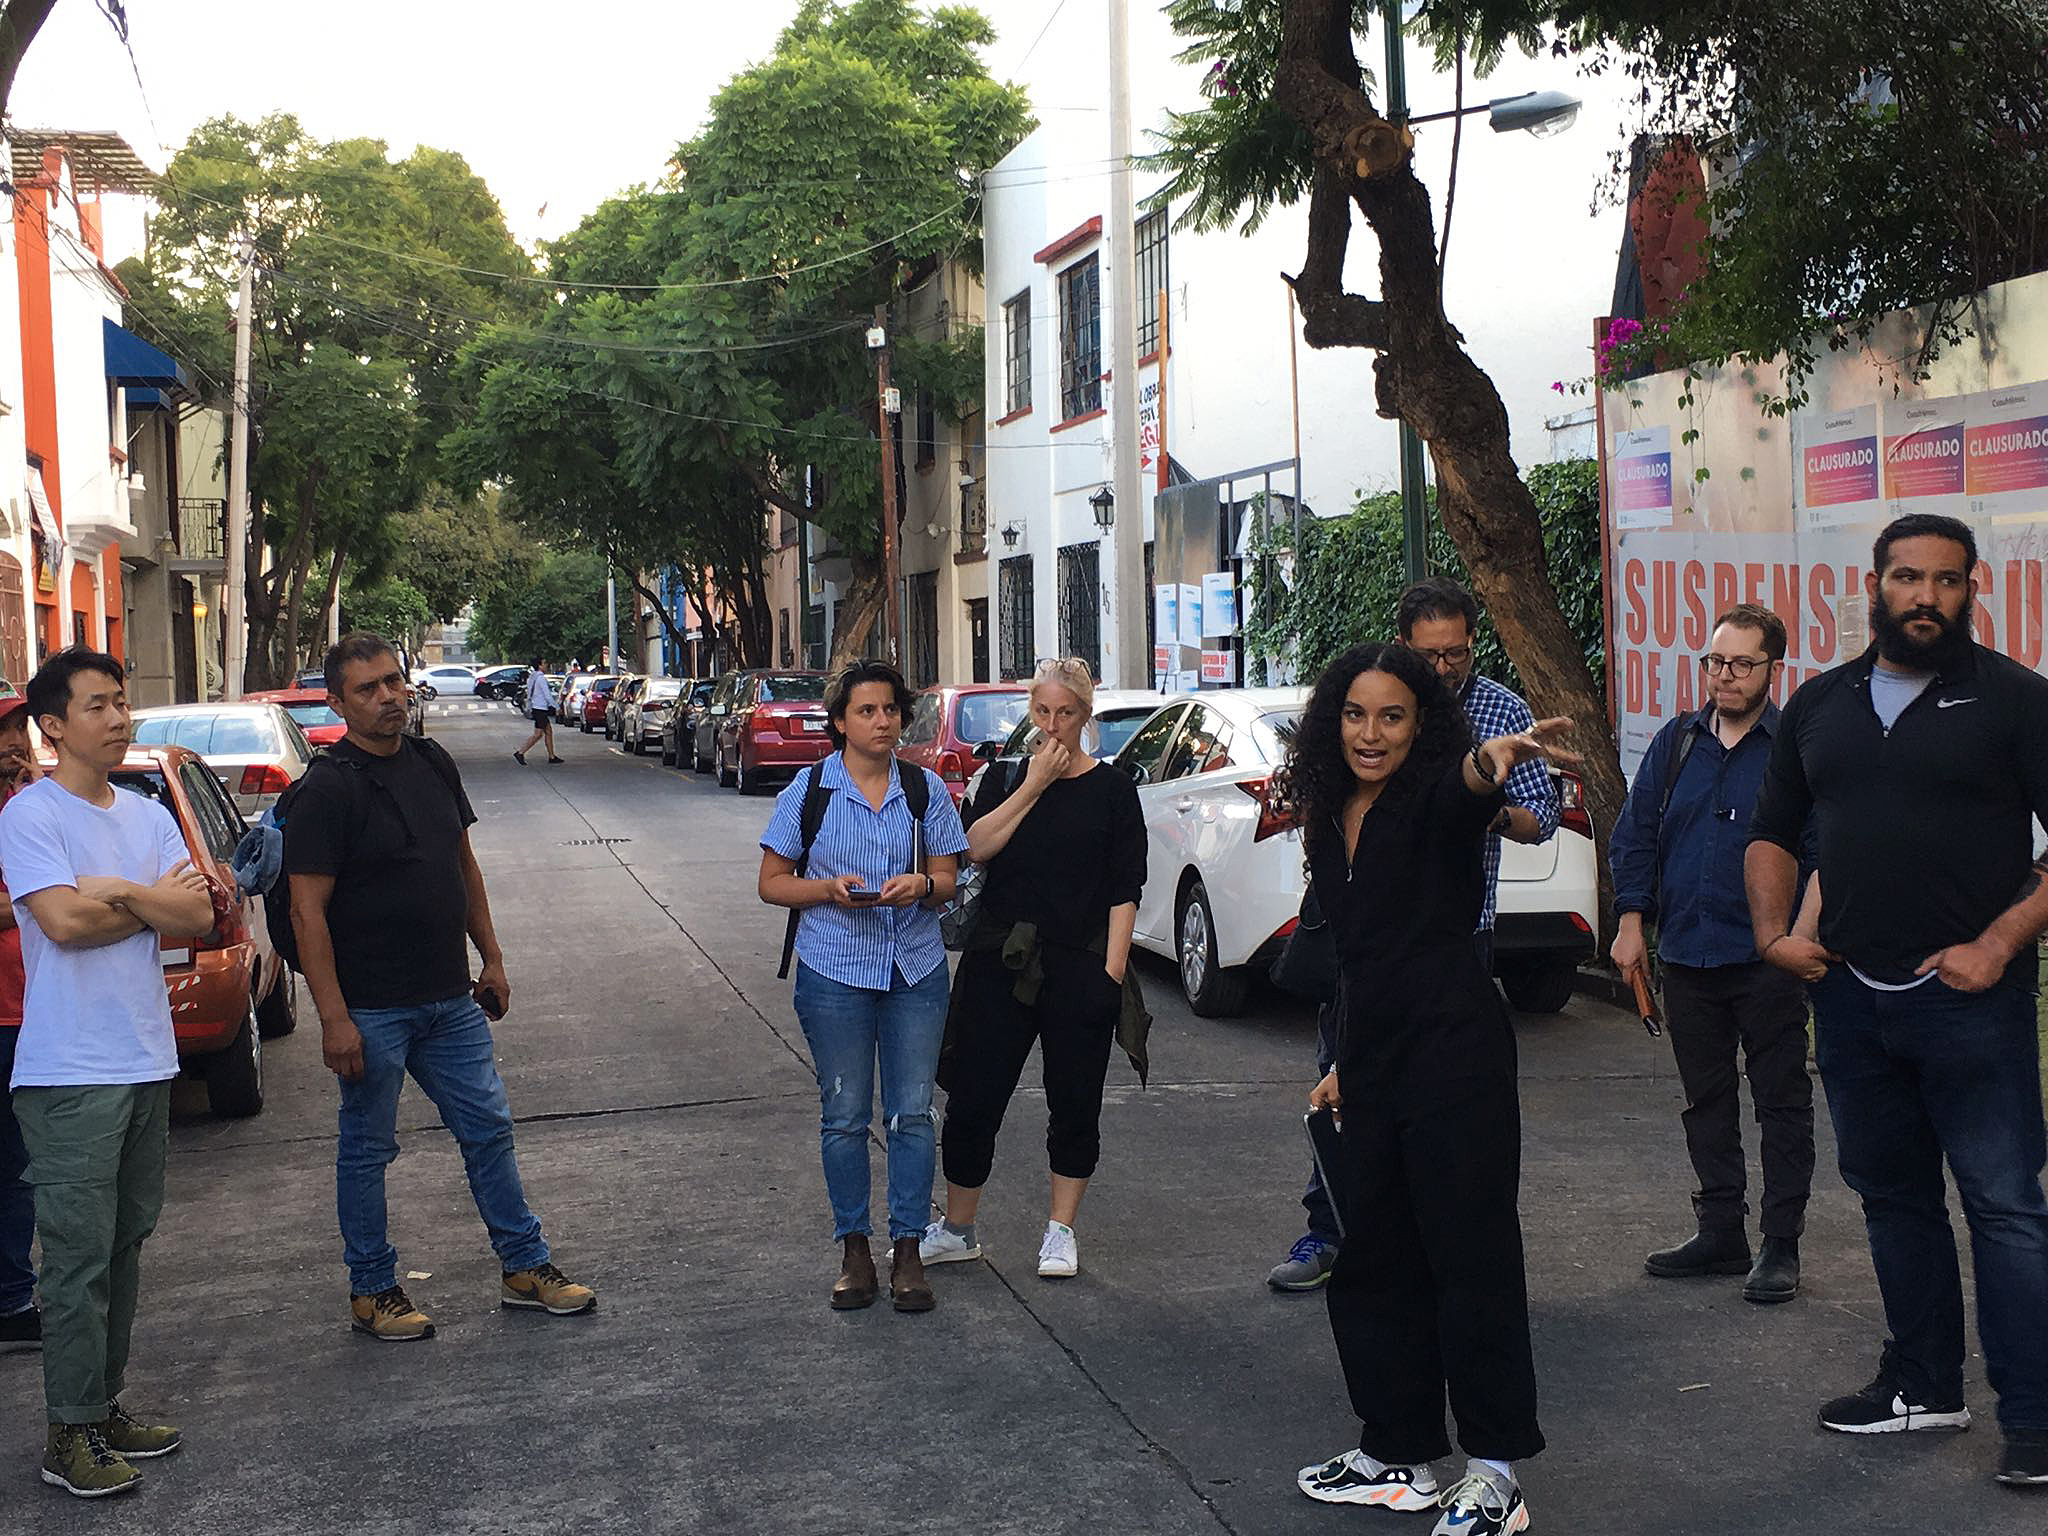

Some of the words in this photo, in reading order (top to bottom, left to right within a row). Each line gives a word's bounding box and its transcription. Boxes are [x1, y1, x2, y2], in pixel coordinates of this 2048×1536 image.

[1807, 448, 1874, 473] CLAUSURADO
[1888, 438, 1960, 463] CLAUSURADO
[1626, 649, 1663, 718] DE
